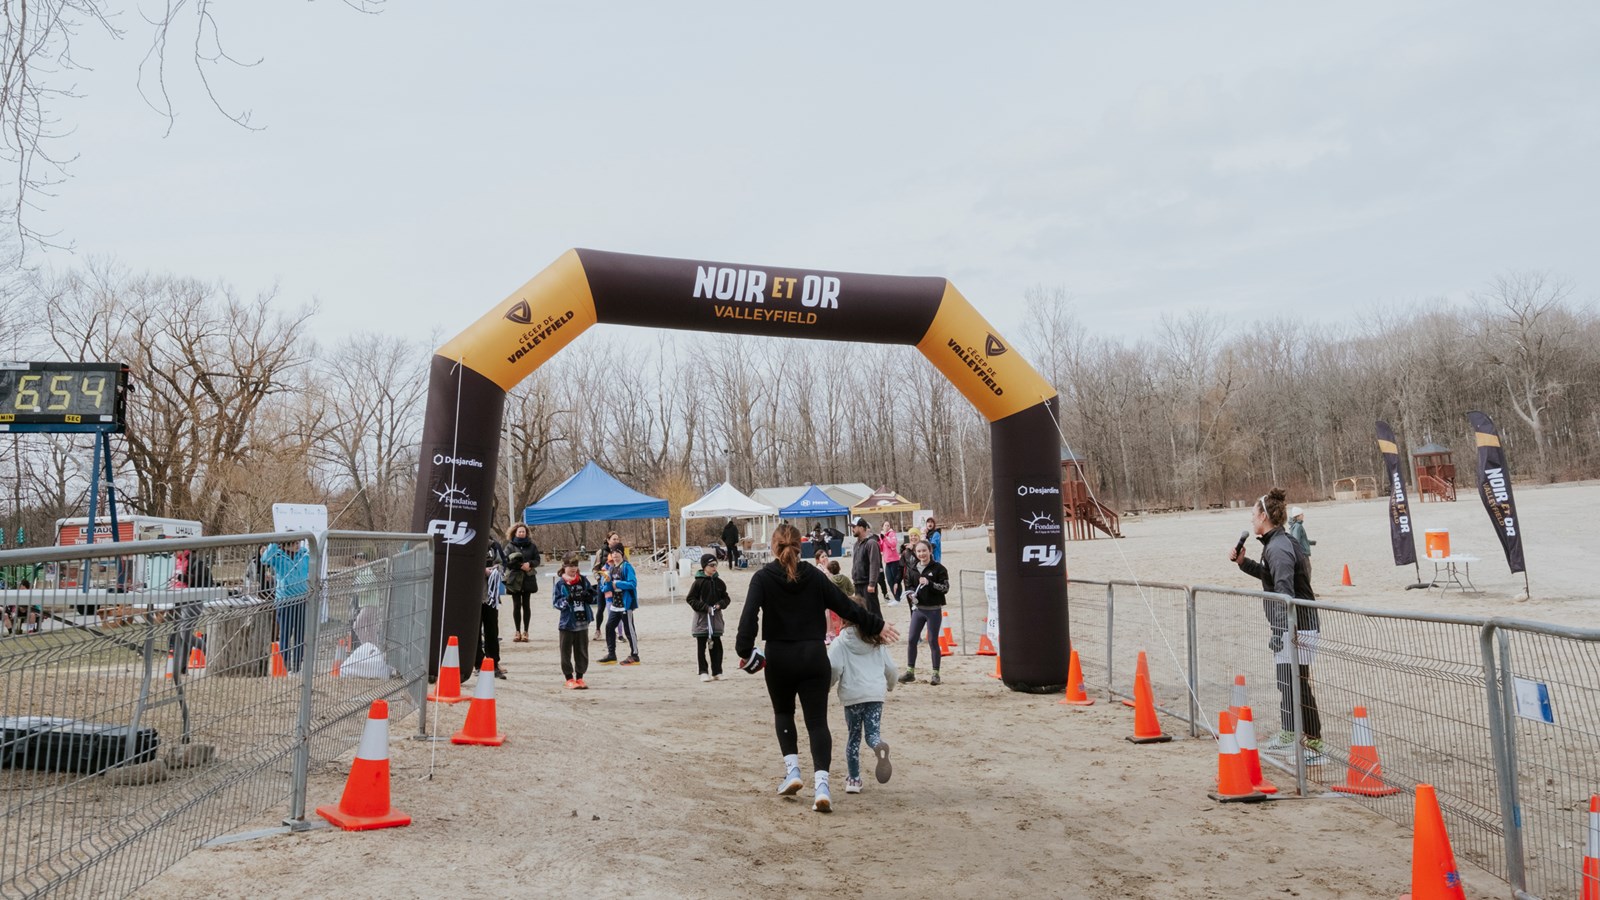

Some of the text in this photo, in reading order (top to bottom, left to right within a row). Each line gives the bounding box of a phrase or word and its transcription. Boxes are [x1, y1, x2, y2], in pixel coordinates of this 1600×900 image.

[692, 266, 841, 310] NOIR ET OR
[543, 315, 555, 326] DE
[714, 304, 818, 325] VALLEYFIELD
[507, 310, 575, 364] VALLEYFIELD
[947, 338, 1004, 397] VALLEYFIELD
[986, 366, 997, 378] DE
[1029, 486, 1059, 496] Desjardins
[1482, 482, 1504, 526] VALLEYFIELD
[1484, 468, 1516, 537] NOIR ET OR
[1399, 515, 1410, 533] OR
